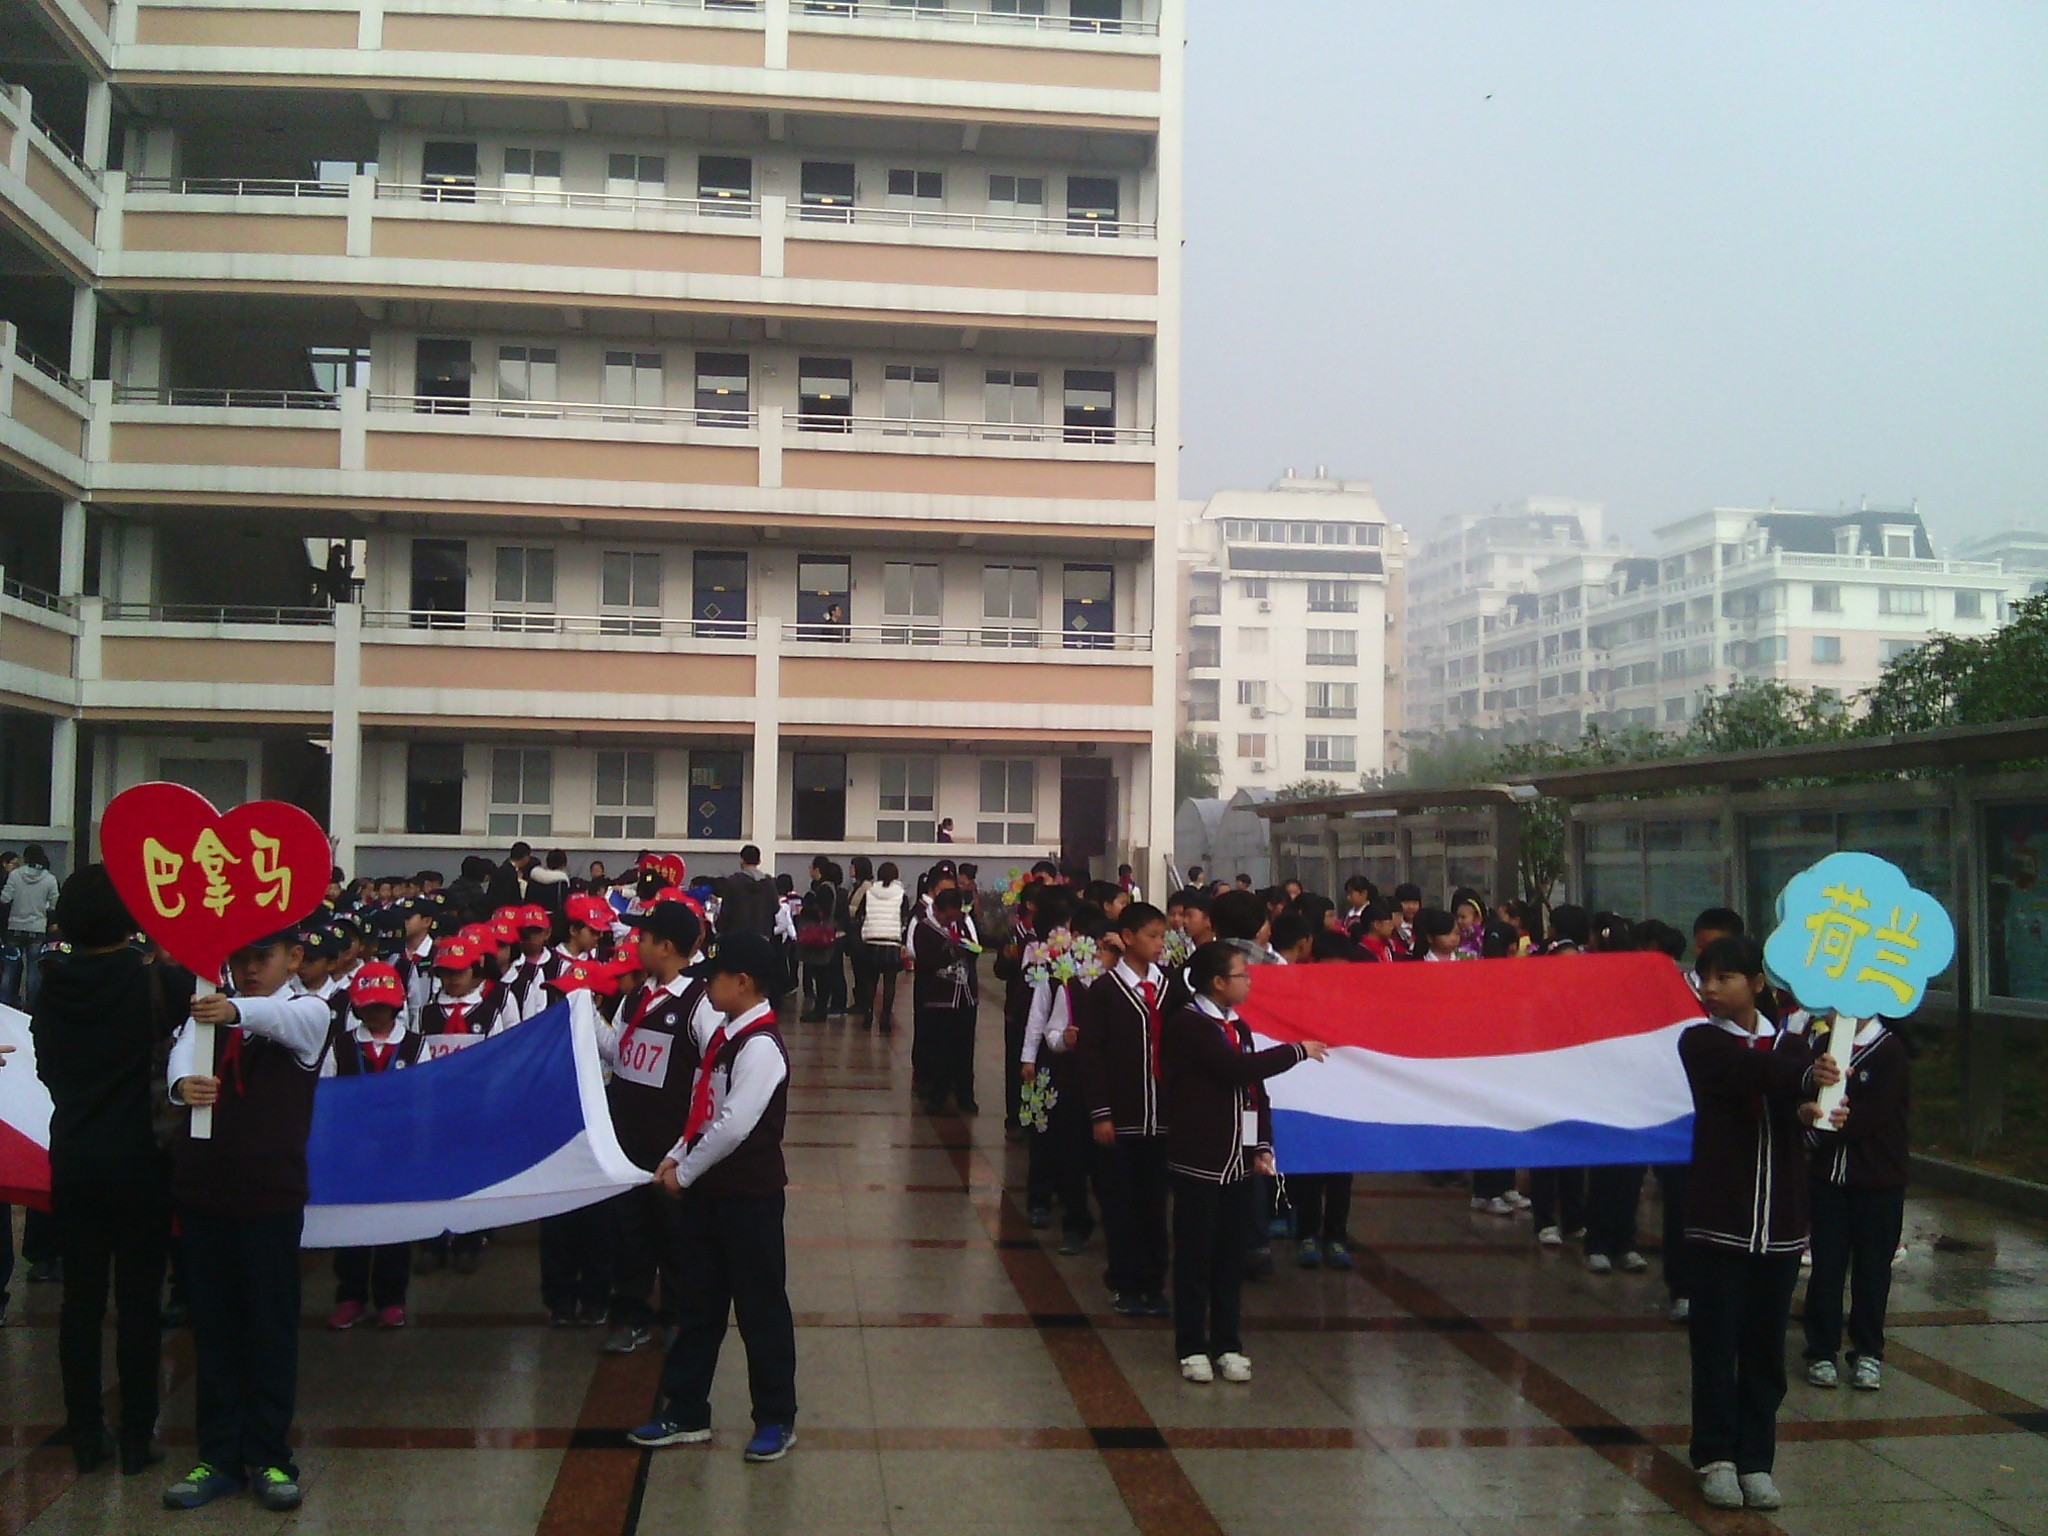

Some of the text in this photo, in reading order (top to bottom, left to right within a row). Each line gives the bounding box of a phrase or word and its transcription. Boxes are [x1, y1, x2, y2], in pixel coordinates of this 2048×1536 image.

[142, 828, 292, 918] 巴拿马
[1804, 882, 1921, 1005] 荷兰
